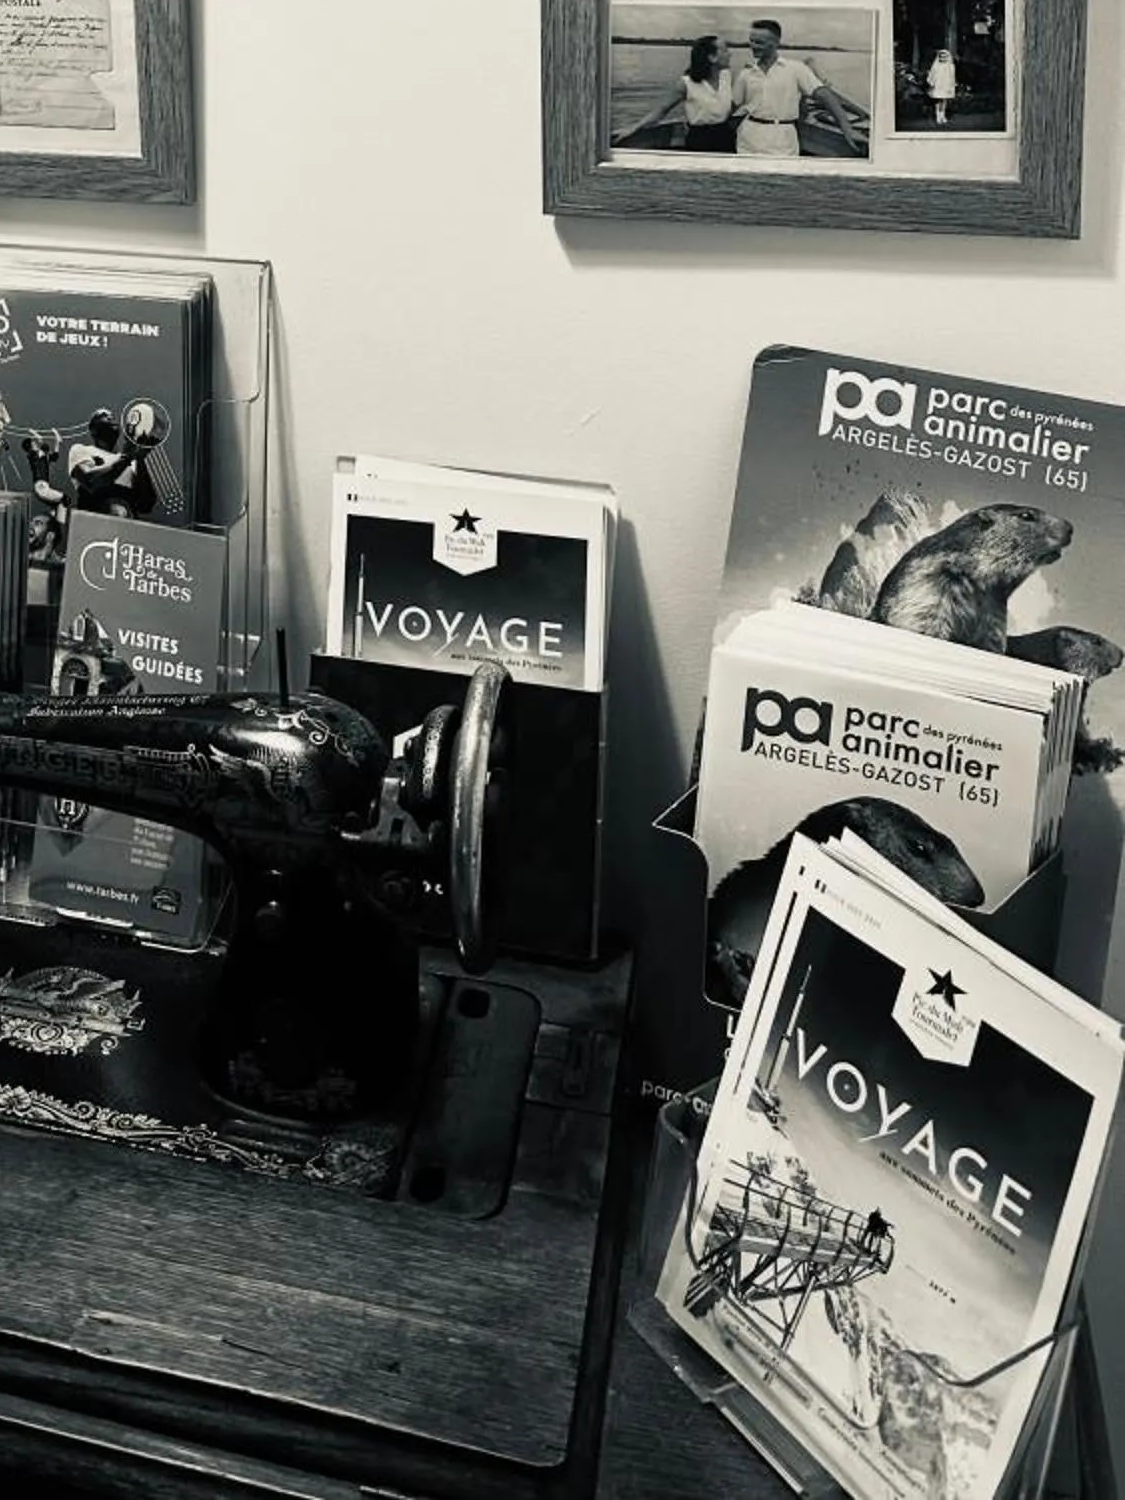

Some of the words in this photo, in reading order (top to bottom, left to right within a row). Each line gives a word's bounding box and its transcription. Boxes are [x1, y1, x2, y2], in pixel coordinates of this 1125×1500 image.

[37, 315, 87, 331] VOTRE
[90, 320, 160, 337] TERRAIN
[37, 332, 57, 344] DE
[60, 334, 100, 348] JEUX
[926, 386, 1008, 420] parc
[1010, 406, 1032, 420] des
[1033, 409, 1094, 431] pyrénées
[832, 423, 1032, 479] ARGELÈS-GAZOST
[1046, 467, 1088, 493] (65)
[923, 413, 1091, 465] animalier
[120, 543, 193, 581] Haras
[122, 566, 192, 602] Tarbes
[118, 628, 178, 654] VISITES
[365, 601, 563, 658] VOYAGE
[132, 655, 203, 685] GUIDÉES
[844, 706, 920, 739] parc
[922, 725, 944, 738] des
[946, 730, 1003, 752] pyrénées
[754, 741, 946, 795] ARGELÈS-GAZOST
[959, 783, 1000, 808] (65)
[842, 731, 1000, 782] animalier
[796, 1027, 1032, 1237] VOYAGE
